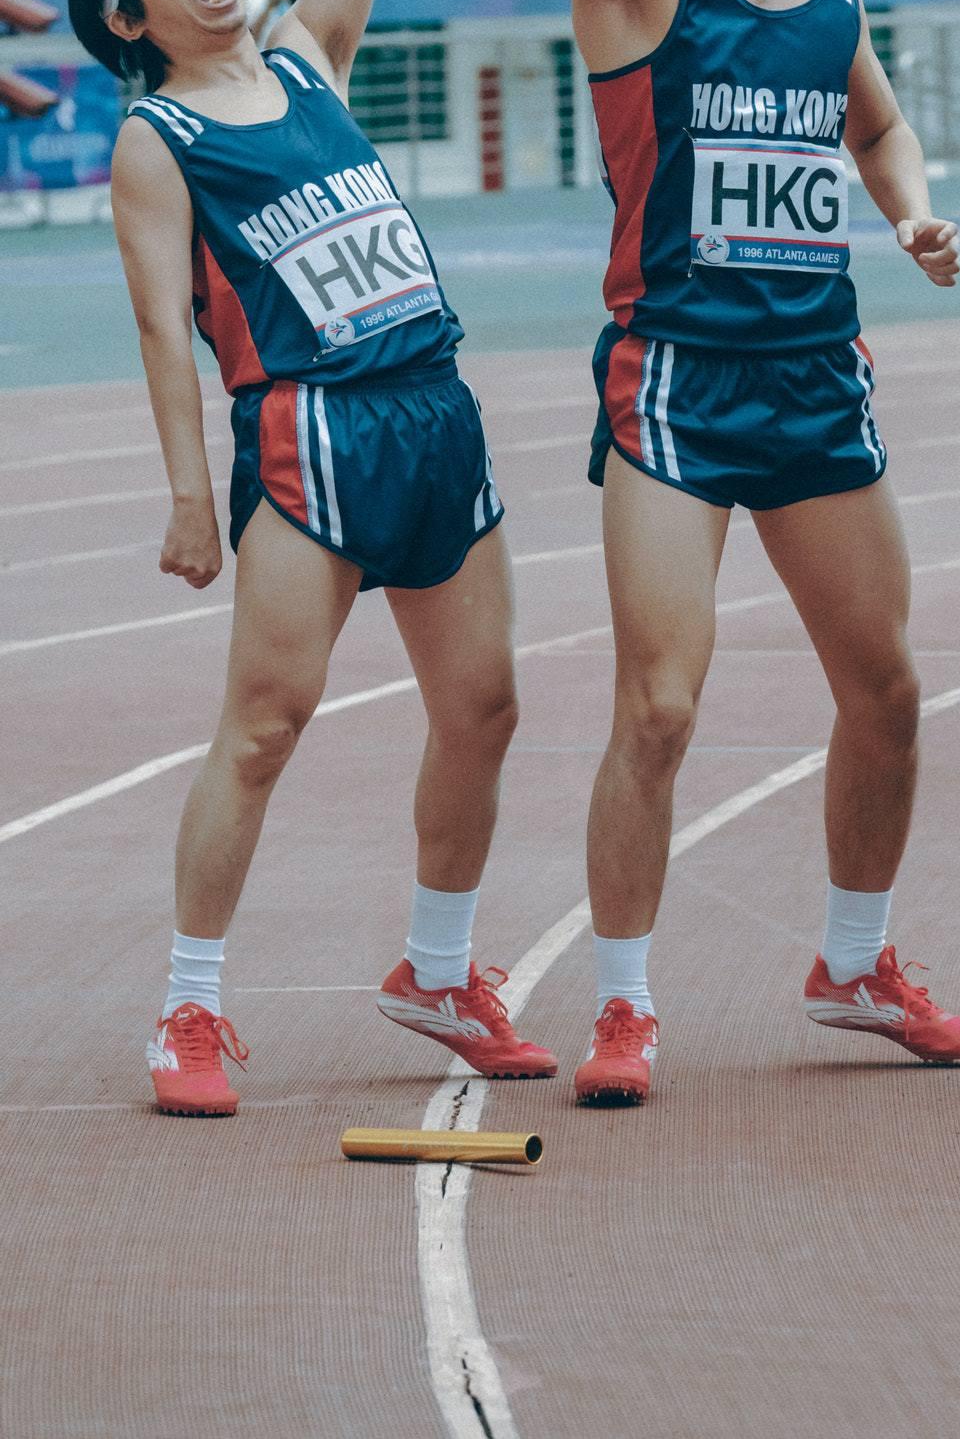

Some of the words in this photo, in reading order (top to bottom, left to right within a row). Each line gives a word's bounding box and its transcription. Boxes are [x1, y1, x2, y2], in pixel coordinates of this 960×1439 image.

[690, 83, 777, 134] HONG
[237, 182, 337, 261] HONG
[711, 161, 840, 233] HKG
[295, 219, 433, 312] HKG
[738, 246, 763, 258] 1996
[765, 248, 807, 262] ATLANTA
[809, 251, 840, 264] GAMES
[360, 312, 385, 329] 1996
[386, 293, 431, 319] ATLANTA
